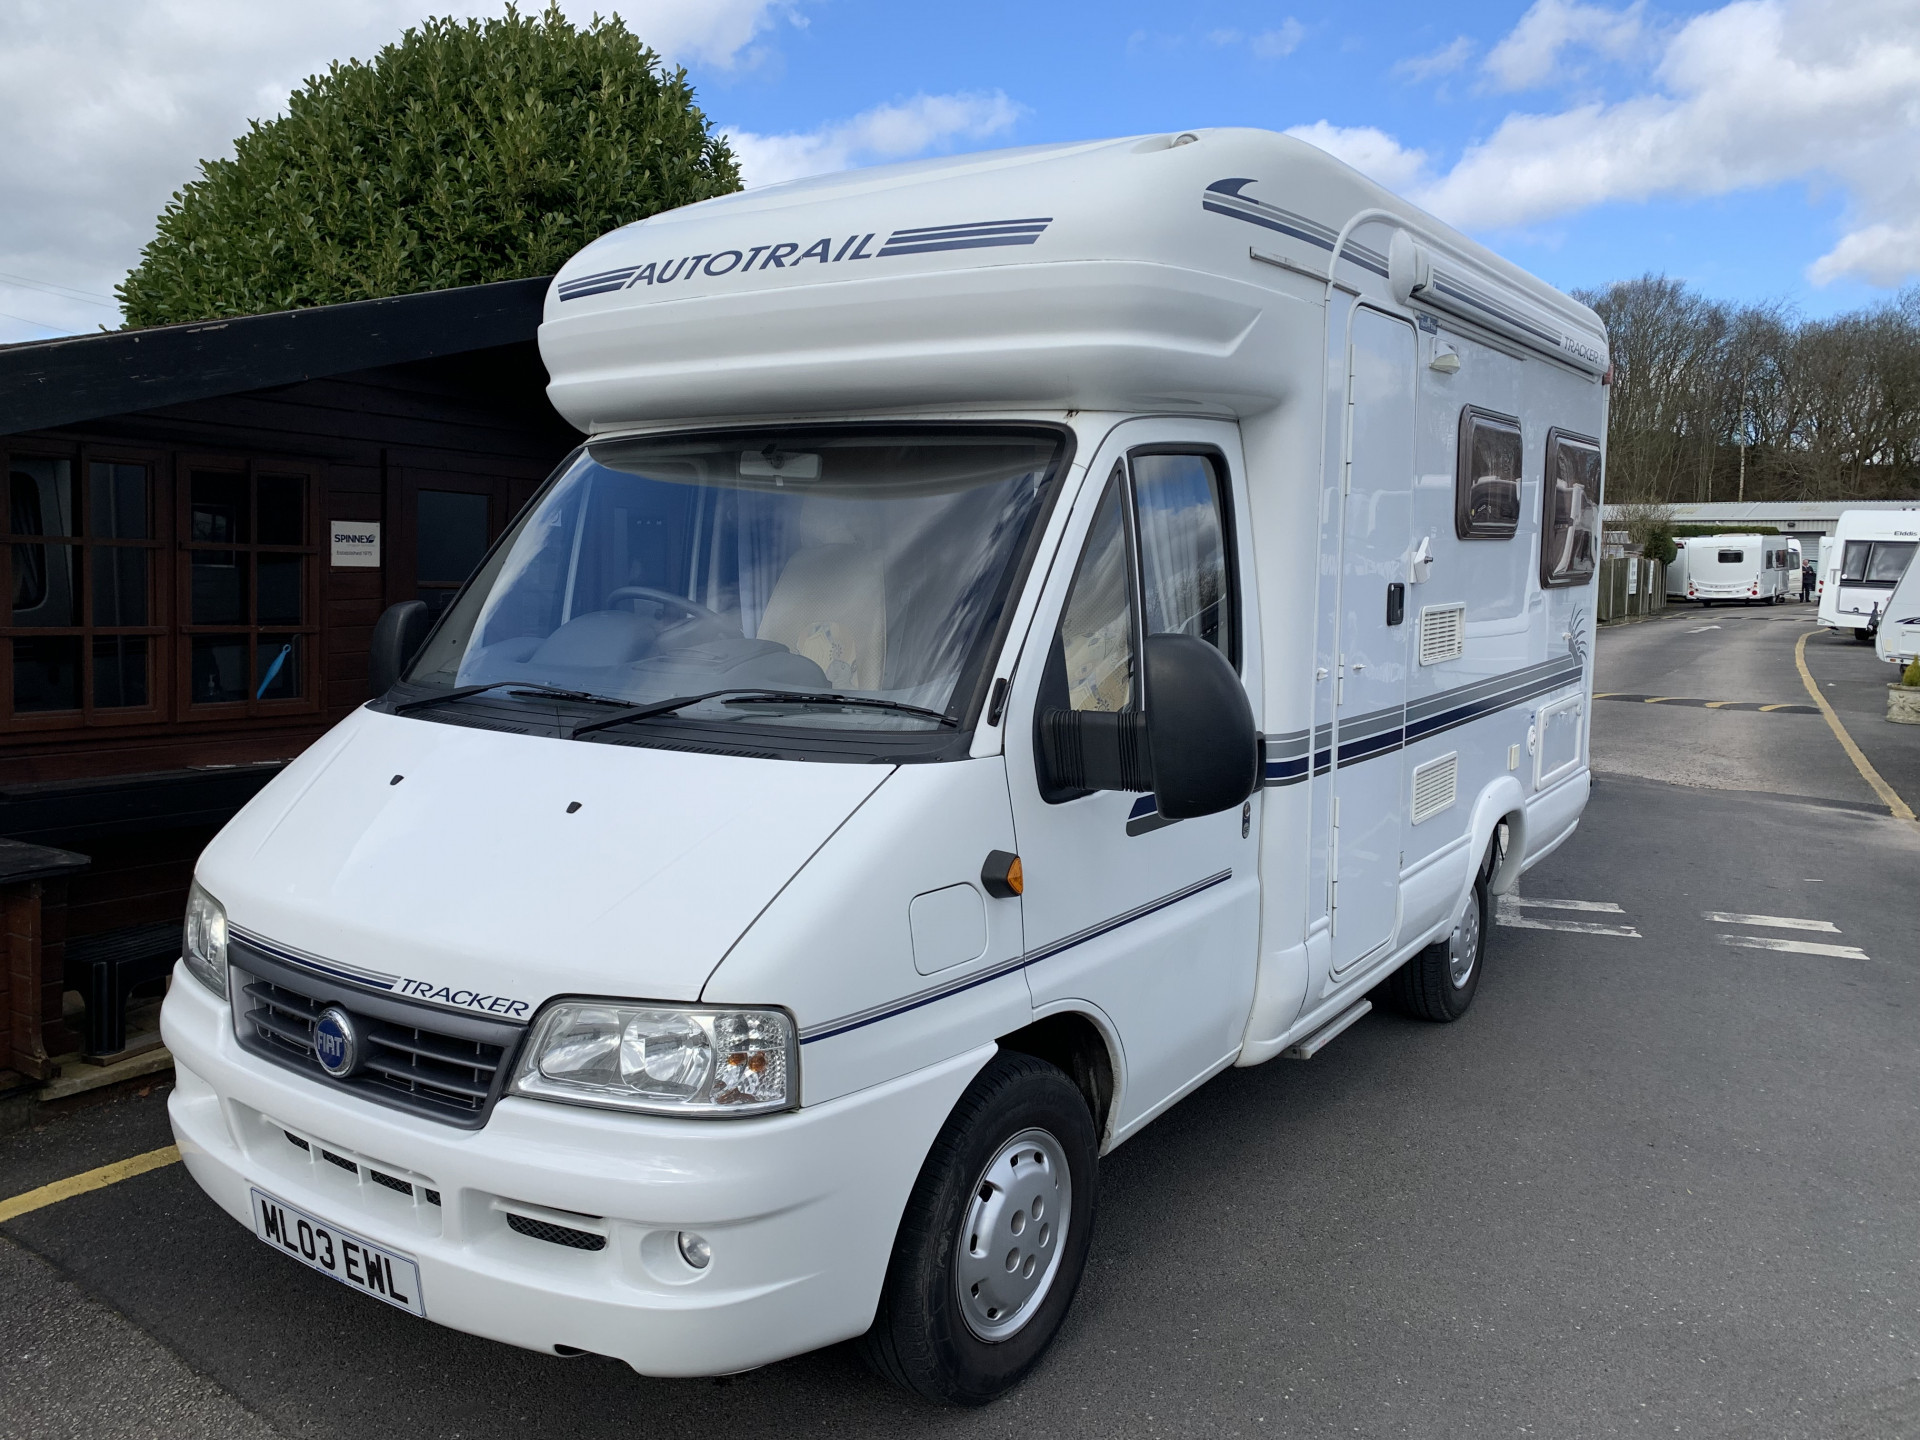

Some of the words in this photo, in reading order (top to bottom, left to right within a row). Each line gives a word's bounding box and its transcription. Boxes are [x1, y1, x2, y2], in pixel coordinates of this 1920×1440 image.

[626, 233, 875, 289] AUTOTRAIL
[1564, 336, 1599, 364] TRACKER
[334, 534, 376, 544] SPINNEY
[401, 978, 529, 1017] TRACKER
[317, 1030, 343, 1057] FIAT
[261, 1199, 336, 1271] ML03
[341, 1238, 409, 1305] EWL
